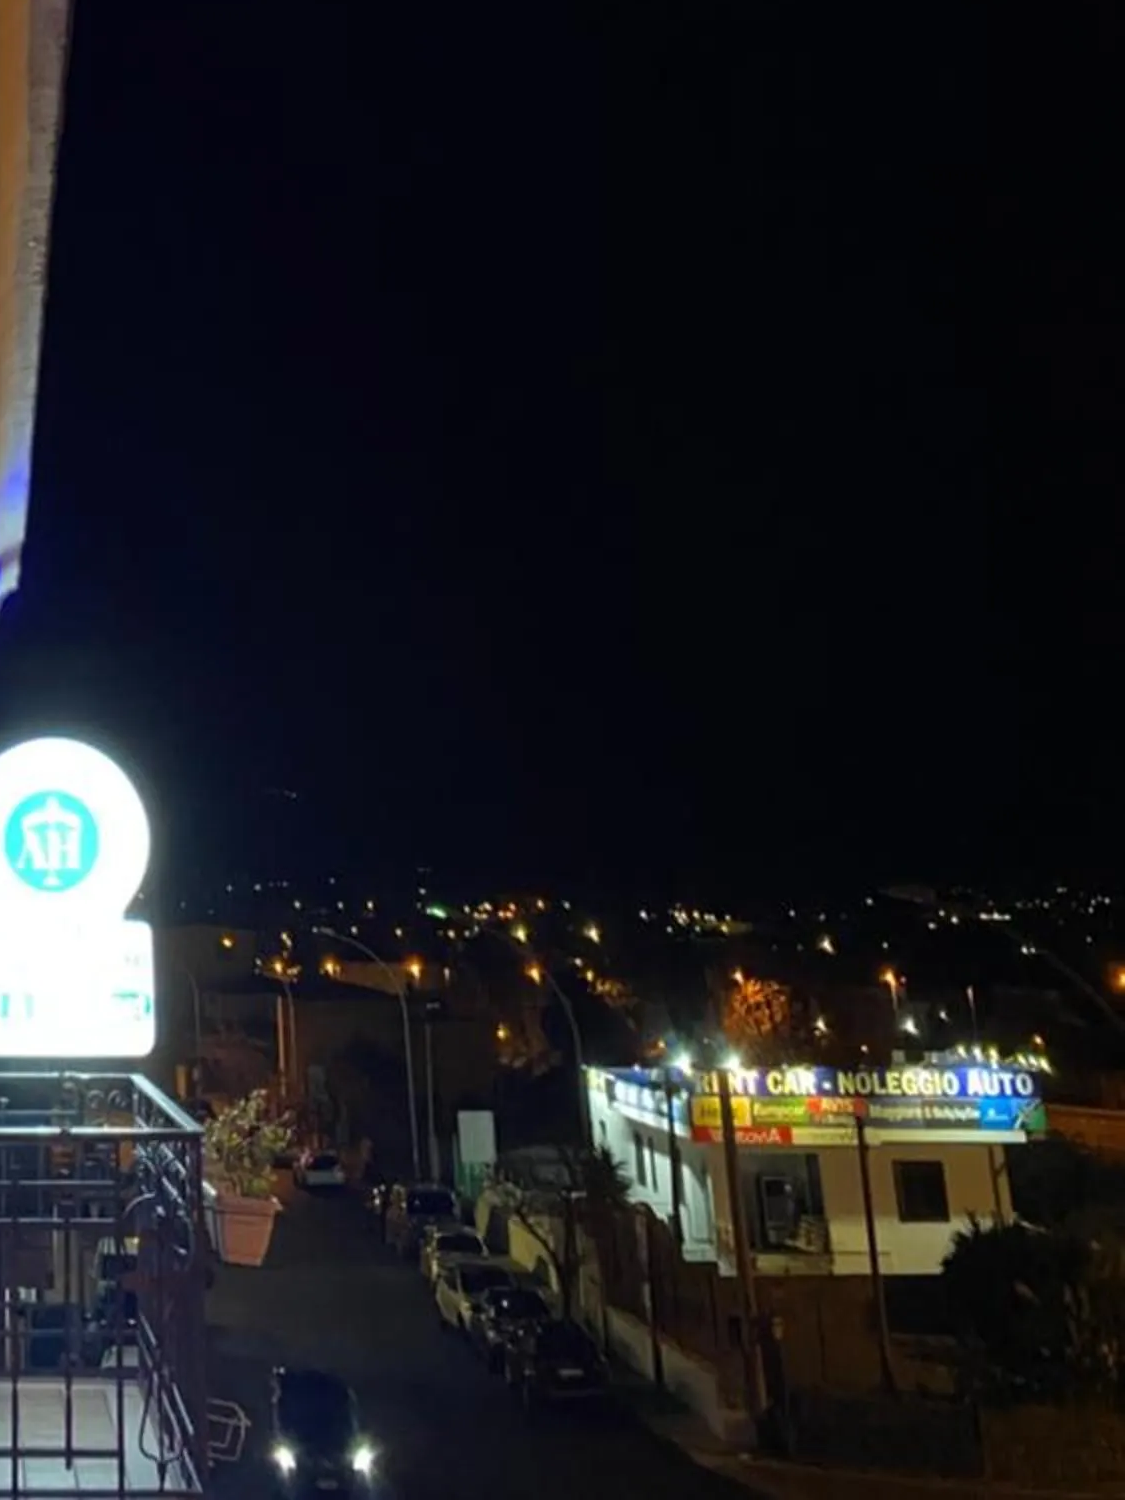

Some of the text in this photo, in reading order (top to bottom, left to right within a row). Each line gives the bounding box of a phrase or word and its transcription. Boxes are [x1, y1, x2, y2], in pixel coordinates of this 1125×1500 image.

[766, 1070, 817, 1095] CAR
[837, 1071, 959, 1096] NOLEGGIO
[967, 1070, 1033, 1096] AUTO
